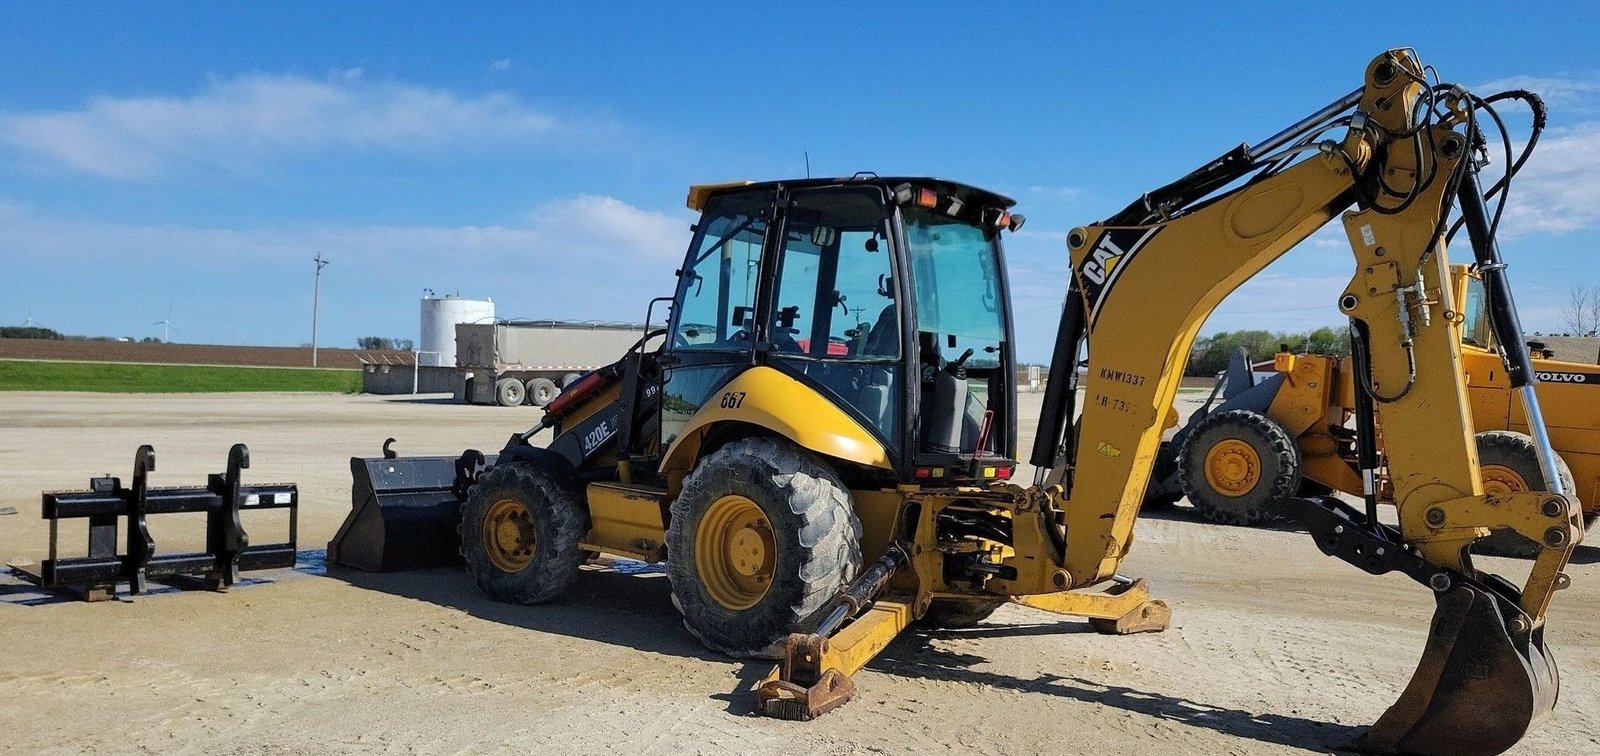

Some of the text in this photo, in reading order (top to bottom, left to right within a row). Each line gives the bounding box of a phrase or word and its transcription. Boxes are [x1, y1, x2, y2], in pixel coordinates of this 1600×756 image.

[1083, 233, 1124, 285] CAT
[720, 391, 746, 409] 667
[584, 421, 610, 451] 420E
